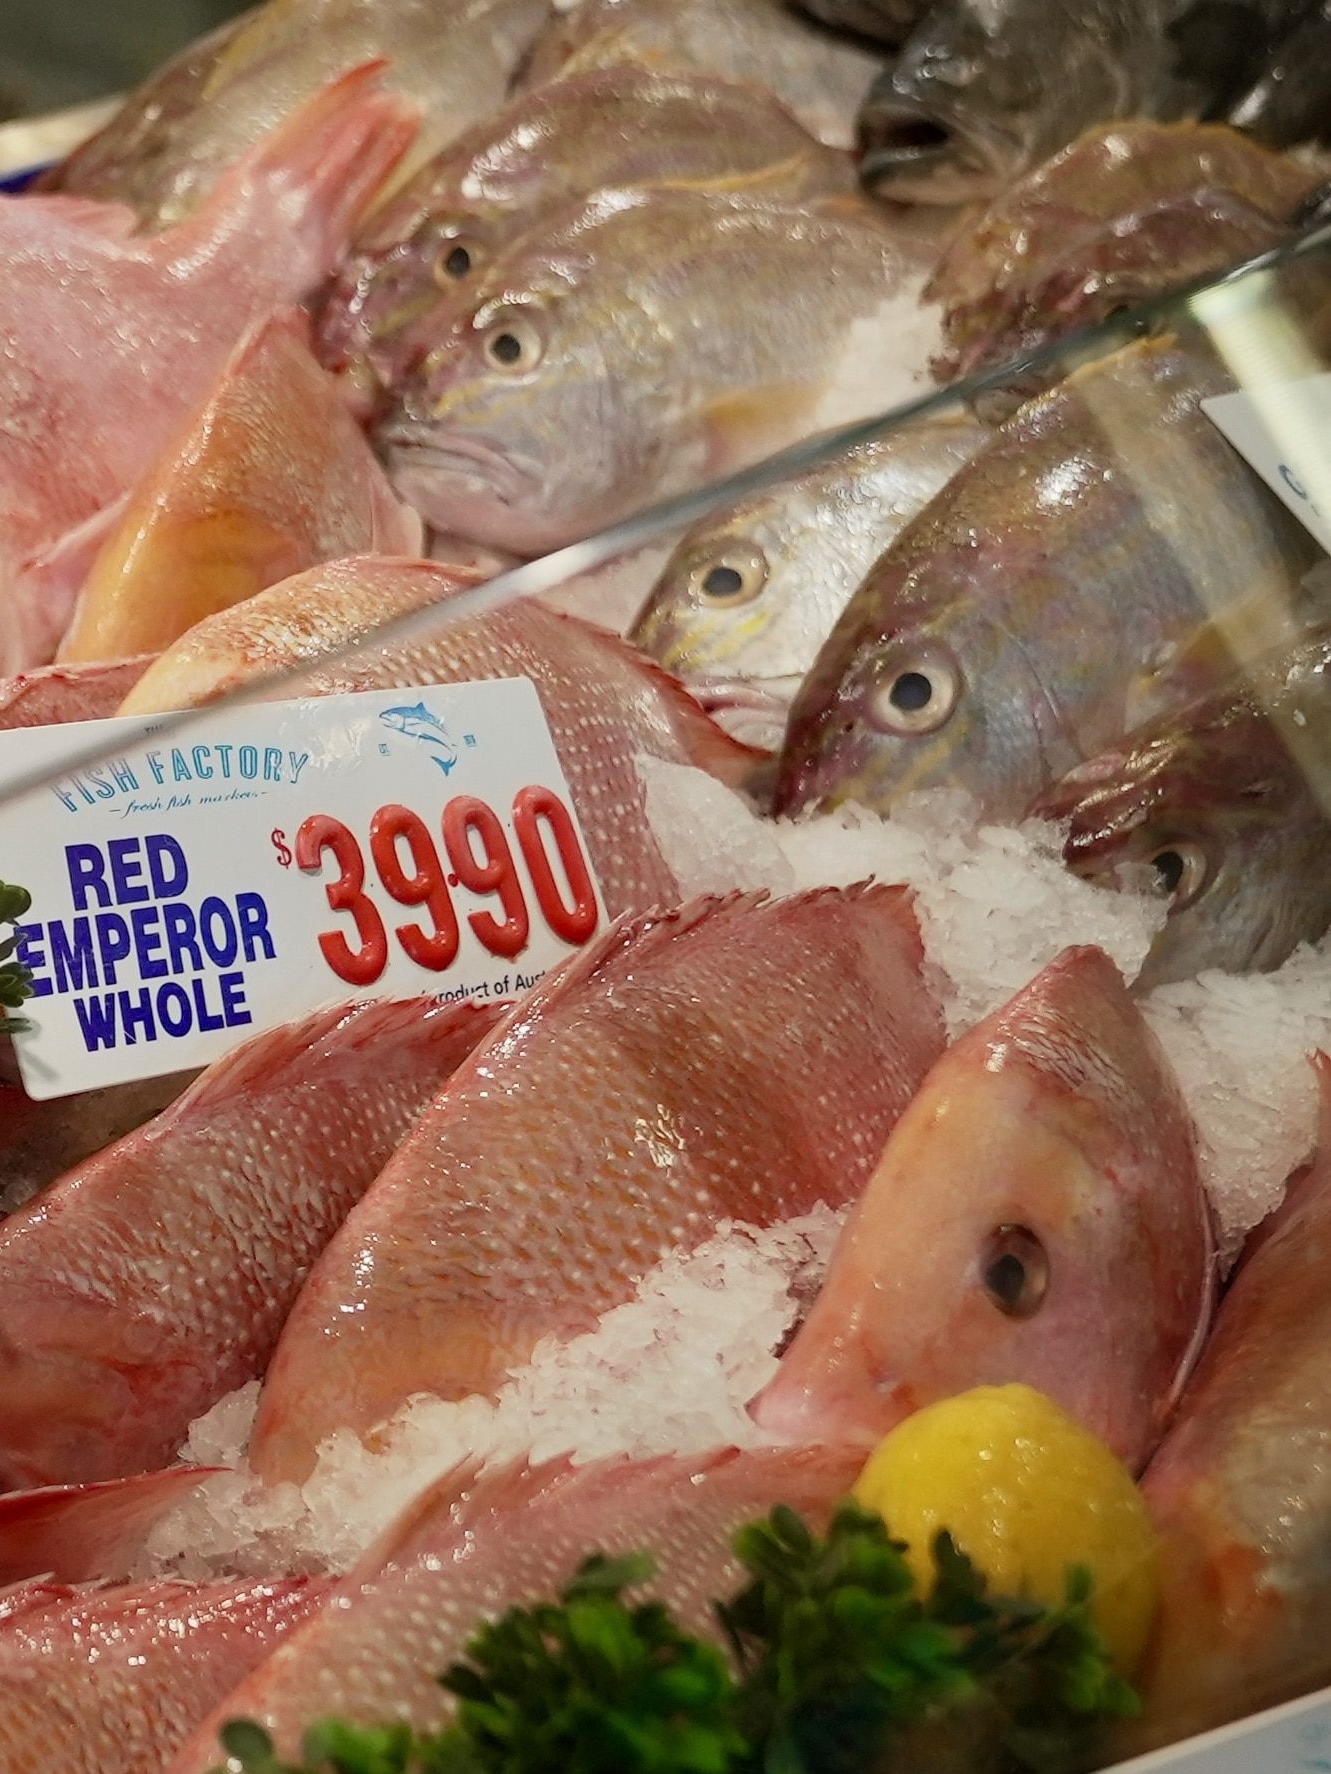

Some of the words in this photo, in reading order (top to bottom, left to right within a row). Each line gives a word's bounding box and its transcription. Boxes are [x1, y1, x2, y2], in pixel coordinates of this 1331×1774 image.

[50, 757, 139, 812] FISH
[146, 745, 309, 784] FACTORY
[65, 834, 188, 911] RED
[14, 892, 277, 999] EMPEROR
[73, 971, 252, 1052] WHOLE
[433, 981, 489, 1002] roduct
[494, 975, 510, 995] of
